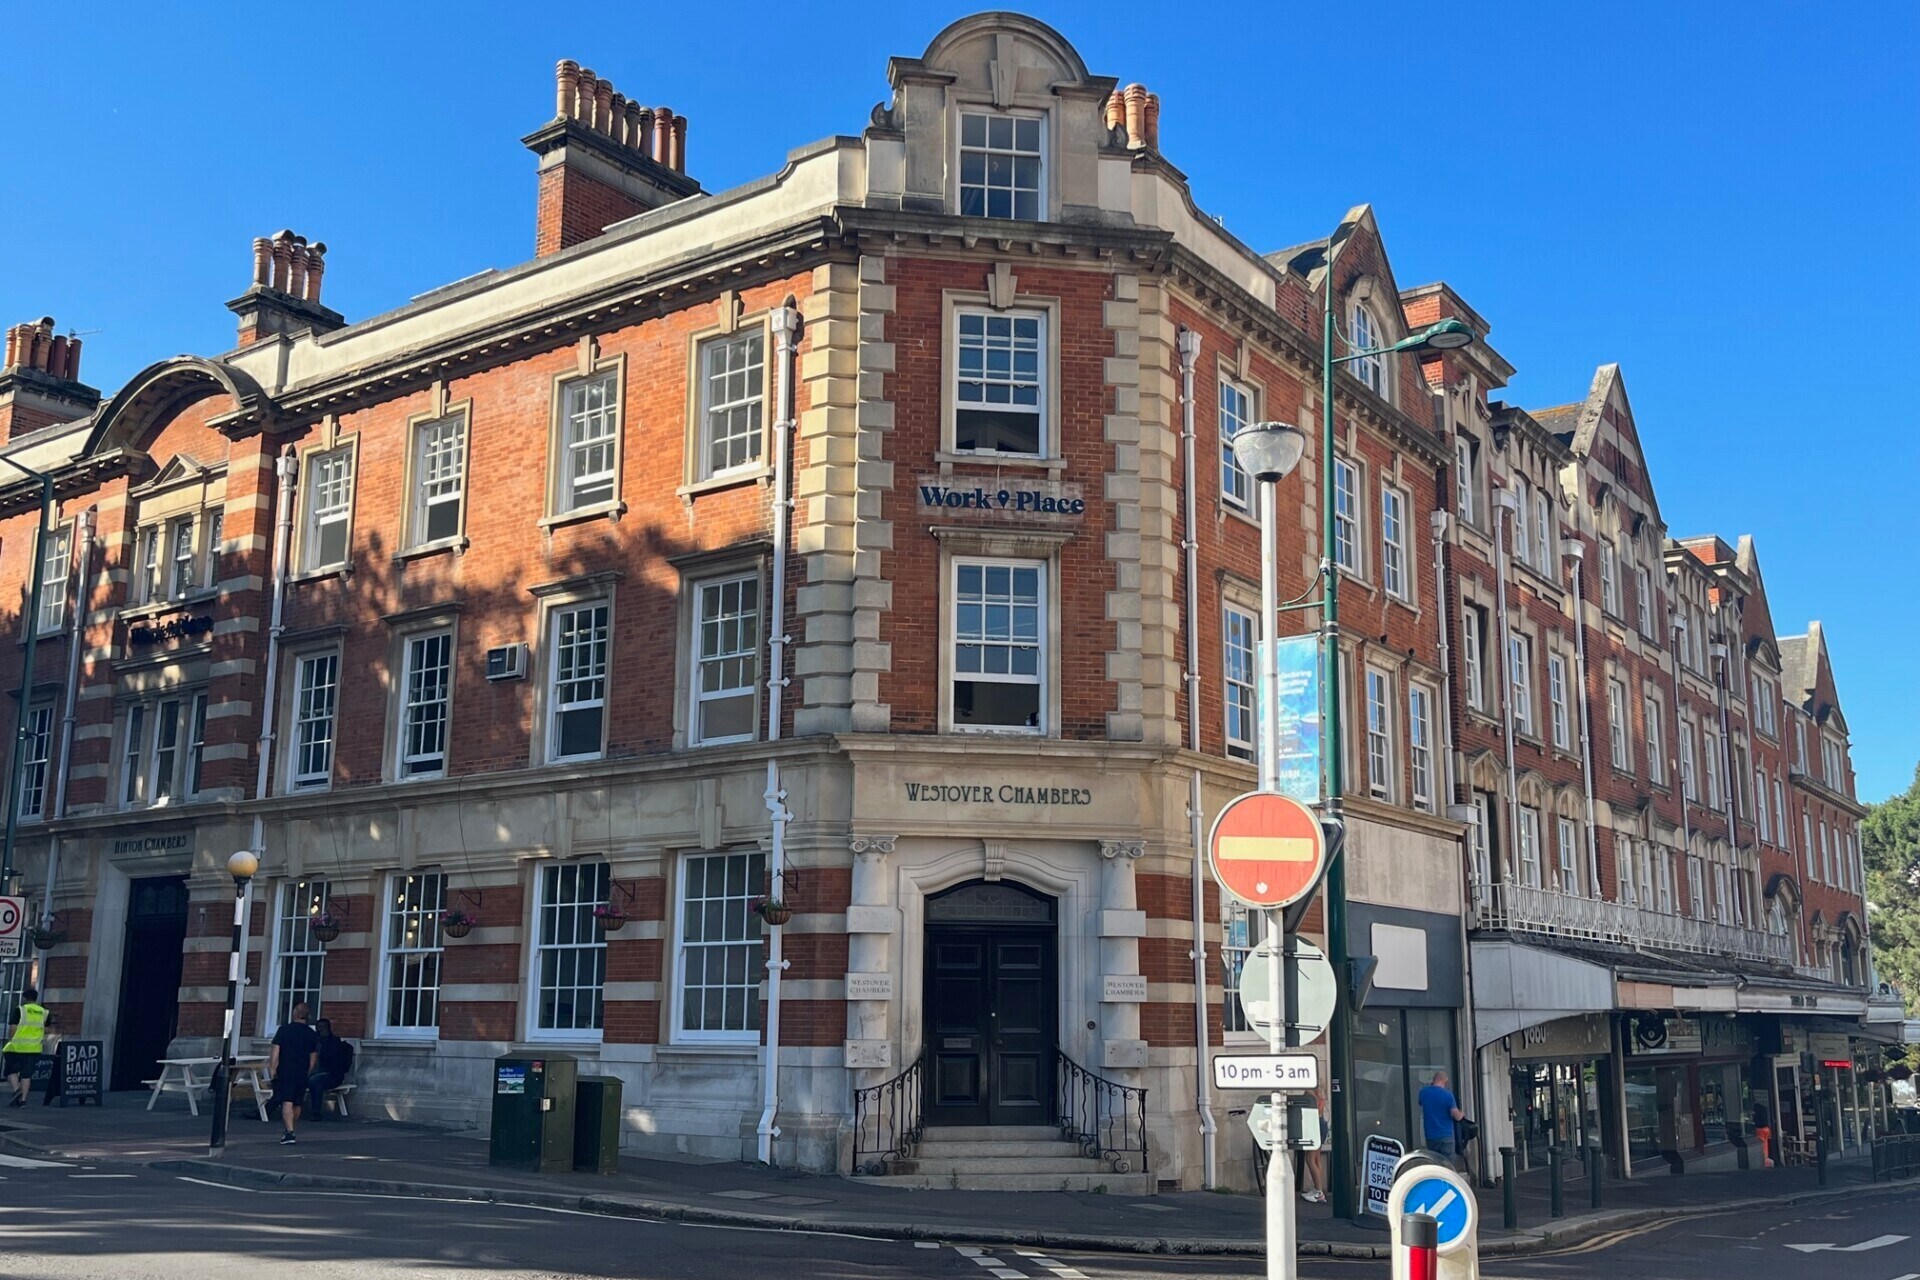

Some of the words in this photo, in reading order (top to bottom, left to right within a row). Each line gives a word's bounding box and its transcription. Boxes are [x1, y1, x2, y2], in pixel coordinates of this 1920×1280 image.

[919, 486, 993, 510] Work
[1015, 490, 1086, 515] Place
[905, 783, 994, 803] WESTOVER
[998, 785, 1092, 805] CHAMBERS
[144, 835, 188, 852] CHAMBERS
[0, 909, 15, 924] 0
[849, 986, 891, 994] CHAMBERS
[851, 979, 890, 987] WESTOVER
[1106, 981, 1145, 989] WESTOVER
[1105, 988, 1145, 996] CHAMBERS
[66, 1045, 98, 1063] BAD
[66, 1058, 98, 1076] HAND
[1221, 1064, 1238, 1079] 10
[1241, 1067, 1262, 1081] pm
[1275, 1064, 1284, 1079] 5
[1288, 1067, 1310, 1079] am
[1370, 1161, 1394, 1176] OFFIC
[1371, 1173, 1393, 1187] SPAC
[1370, 1187, 1382, 1200] TO
